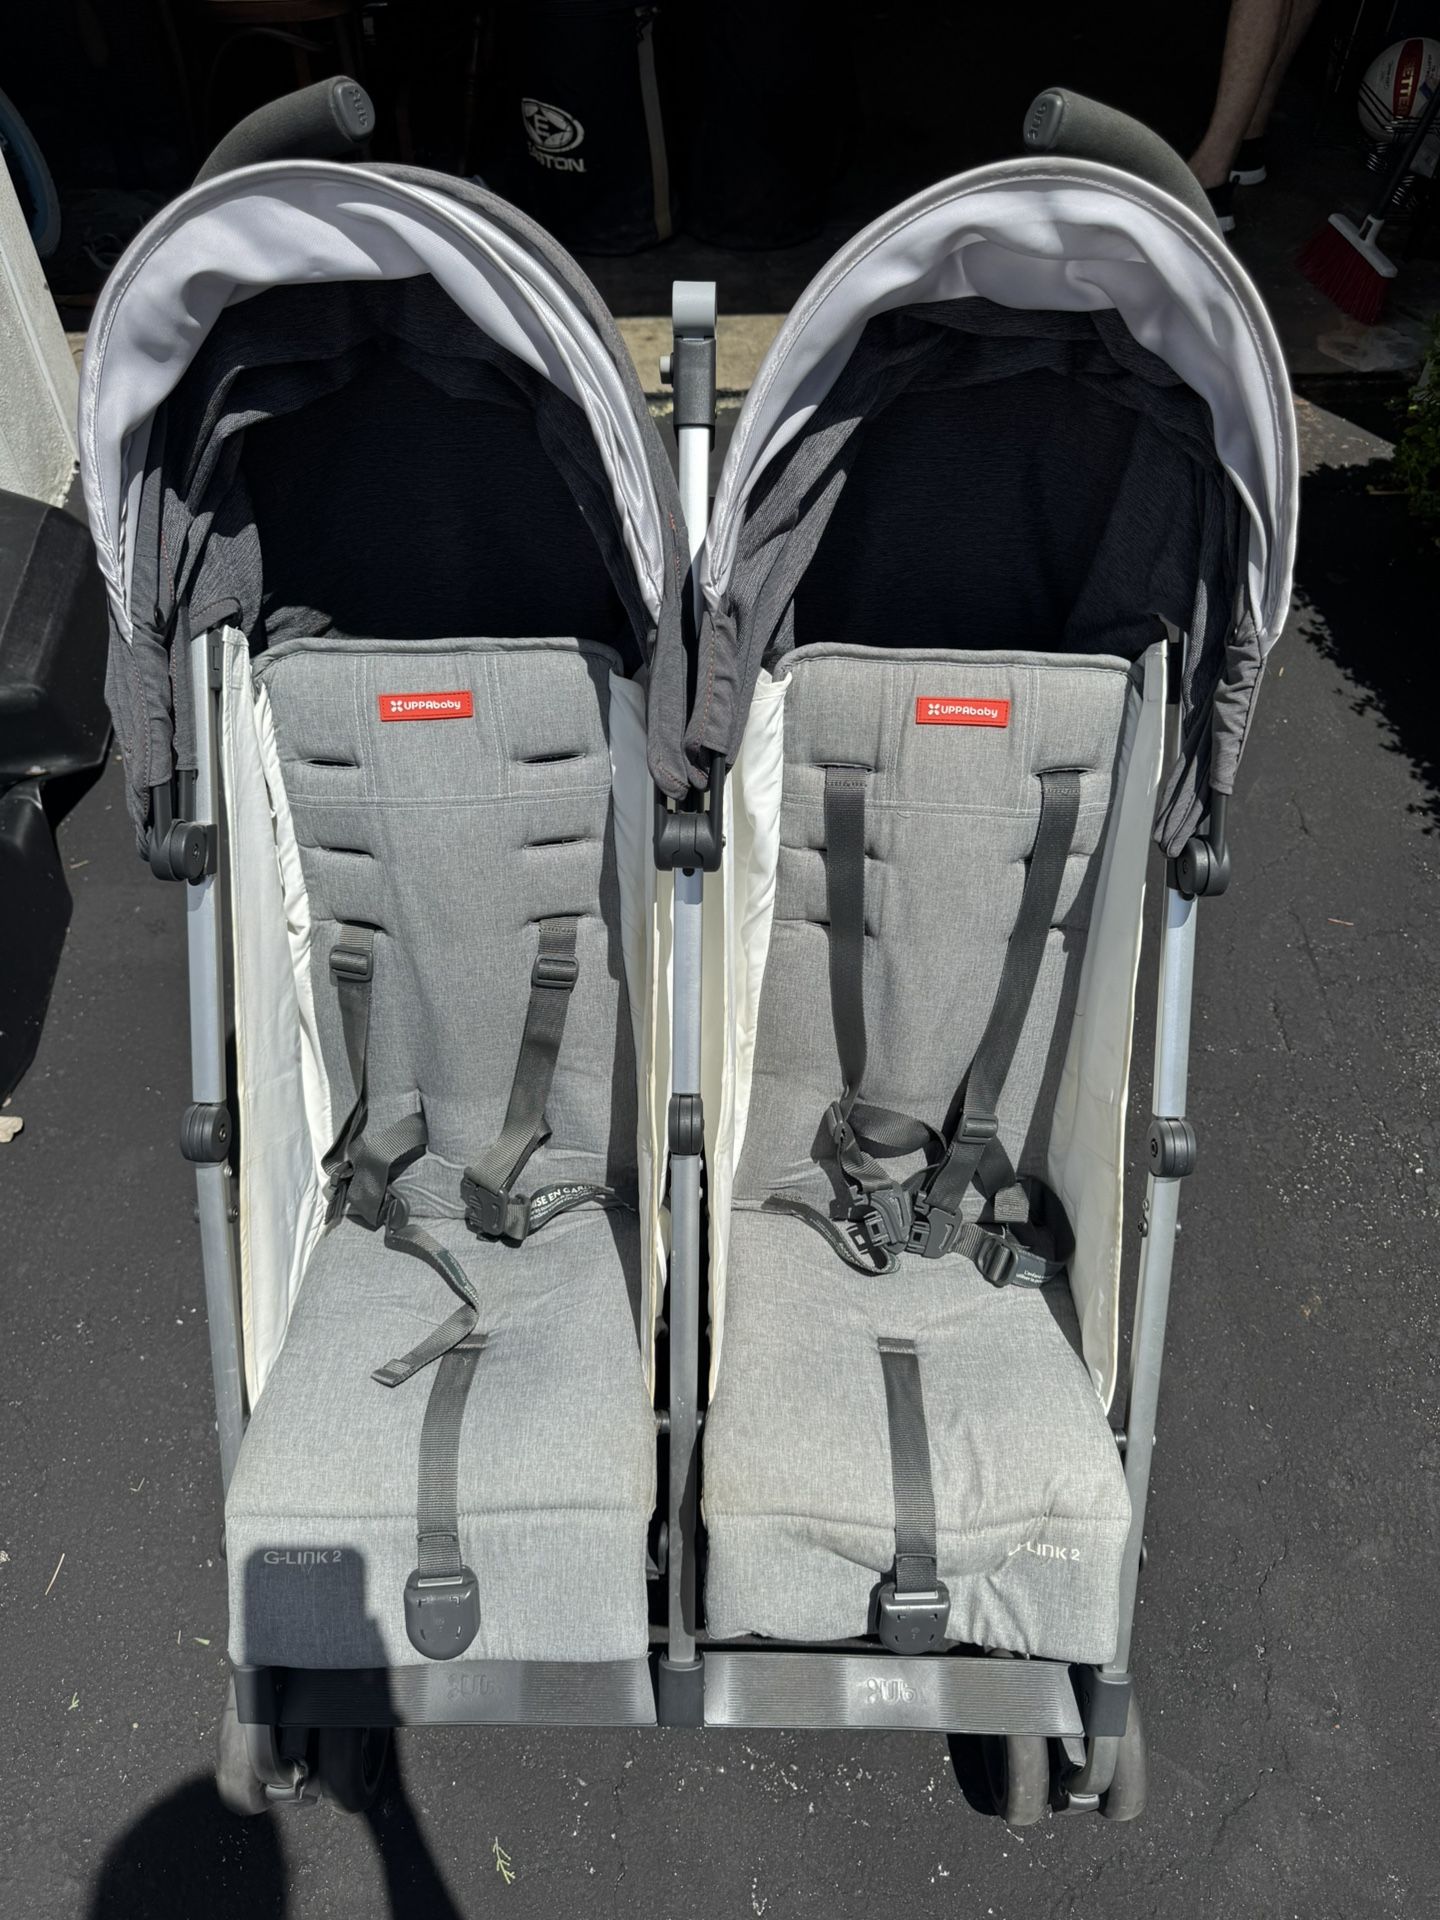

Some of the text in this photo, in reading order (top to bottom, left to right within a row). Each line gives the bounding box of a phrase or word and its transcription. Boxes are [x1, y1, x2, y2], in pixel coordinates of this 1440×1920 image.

[403, 700, 461, 710] UPPAbaby
[941, 705, 998, 718] UPPAbaby
[533, 1195, 548, 1207] ISE
[548, 1188, 561, 1201] EN
[263, 1550, 342, 1565] G-LINK 2
[1071, 1548, 1080, 1561] 2
